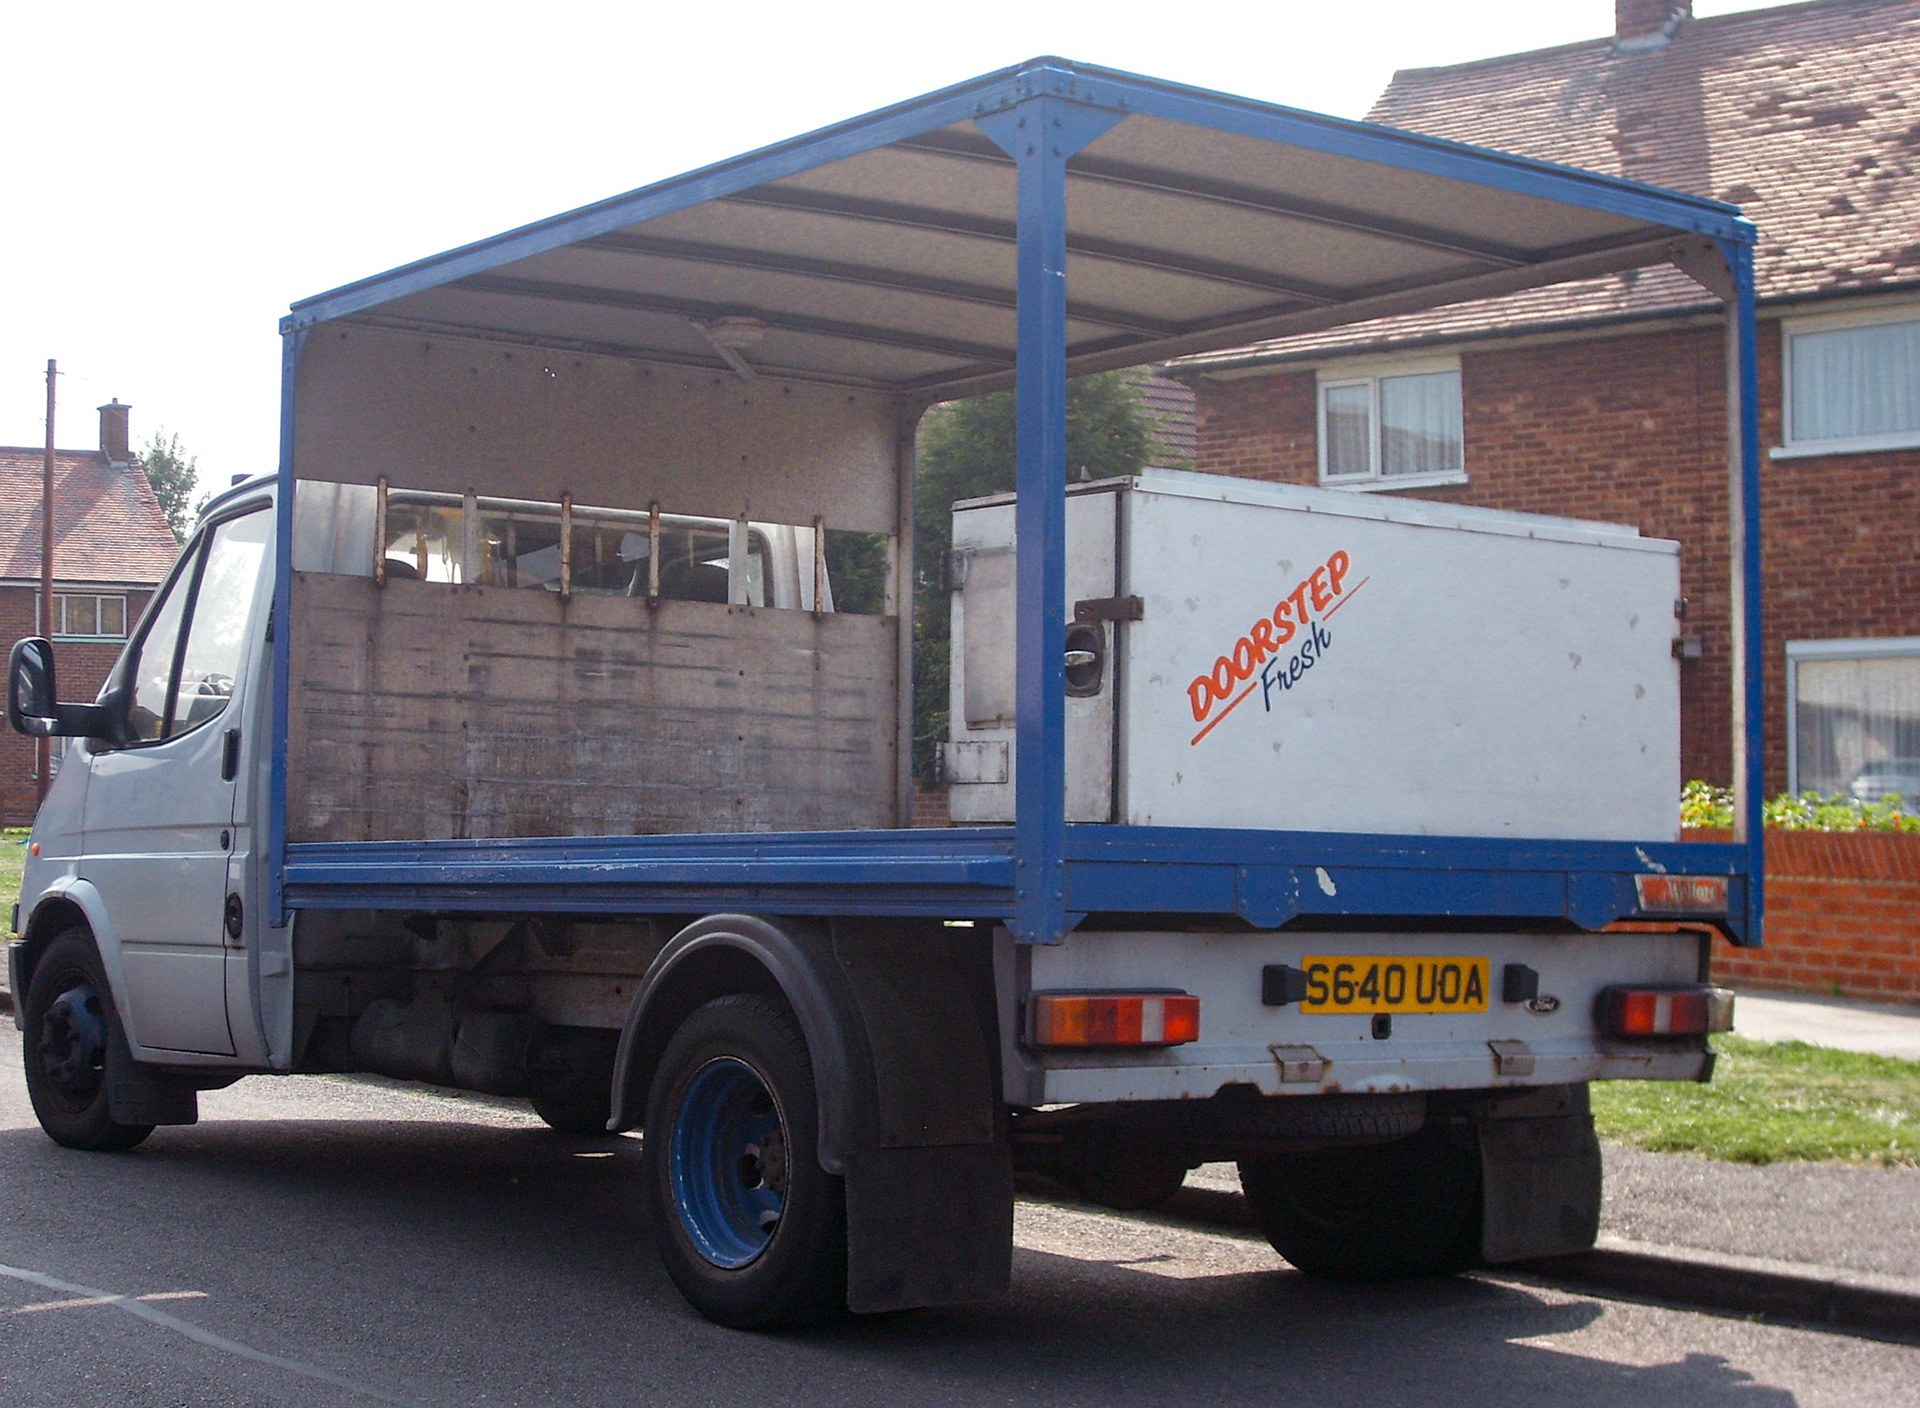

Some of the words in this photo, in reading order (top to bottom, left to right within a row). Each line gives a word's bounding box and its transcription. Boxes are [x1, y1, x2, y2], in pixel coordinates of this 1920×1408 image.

[1187, 550, 1350, 722] DOORSTEP
[1261, 621, 1331, 712] Fresh
[1307, 964, 1406, 1005] S640
[1416, 964, 1484, 1005] UOA
